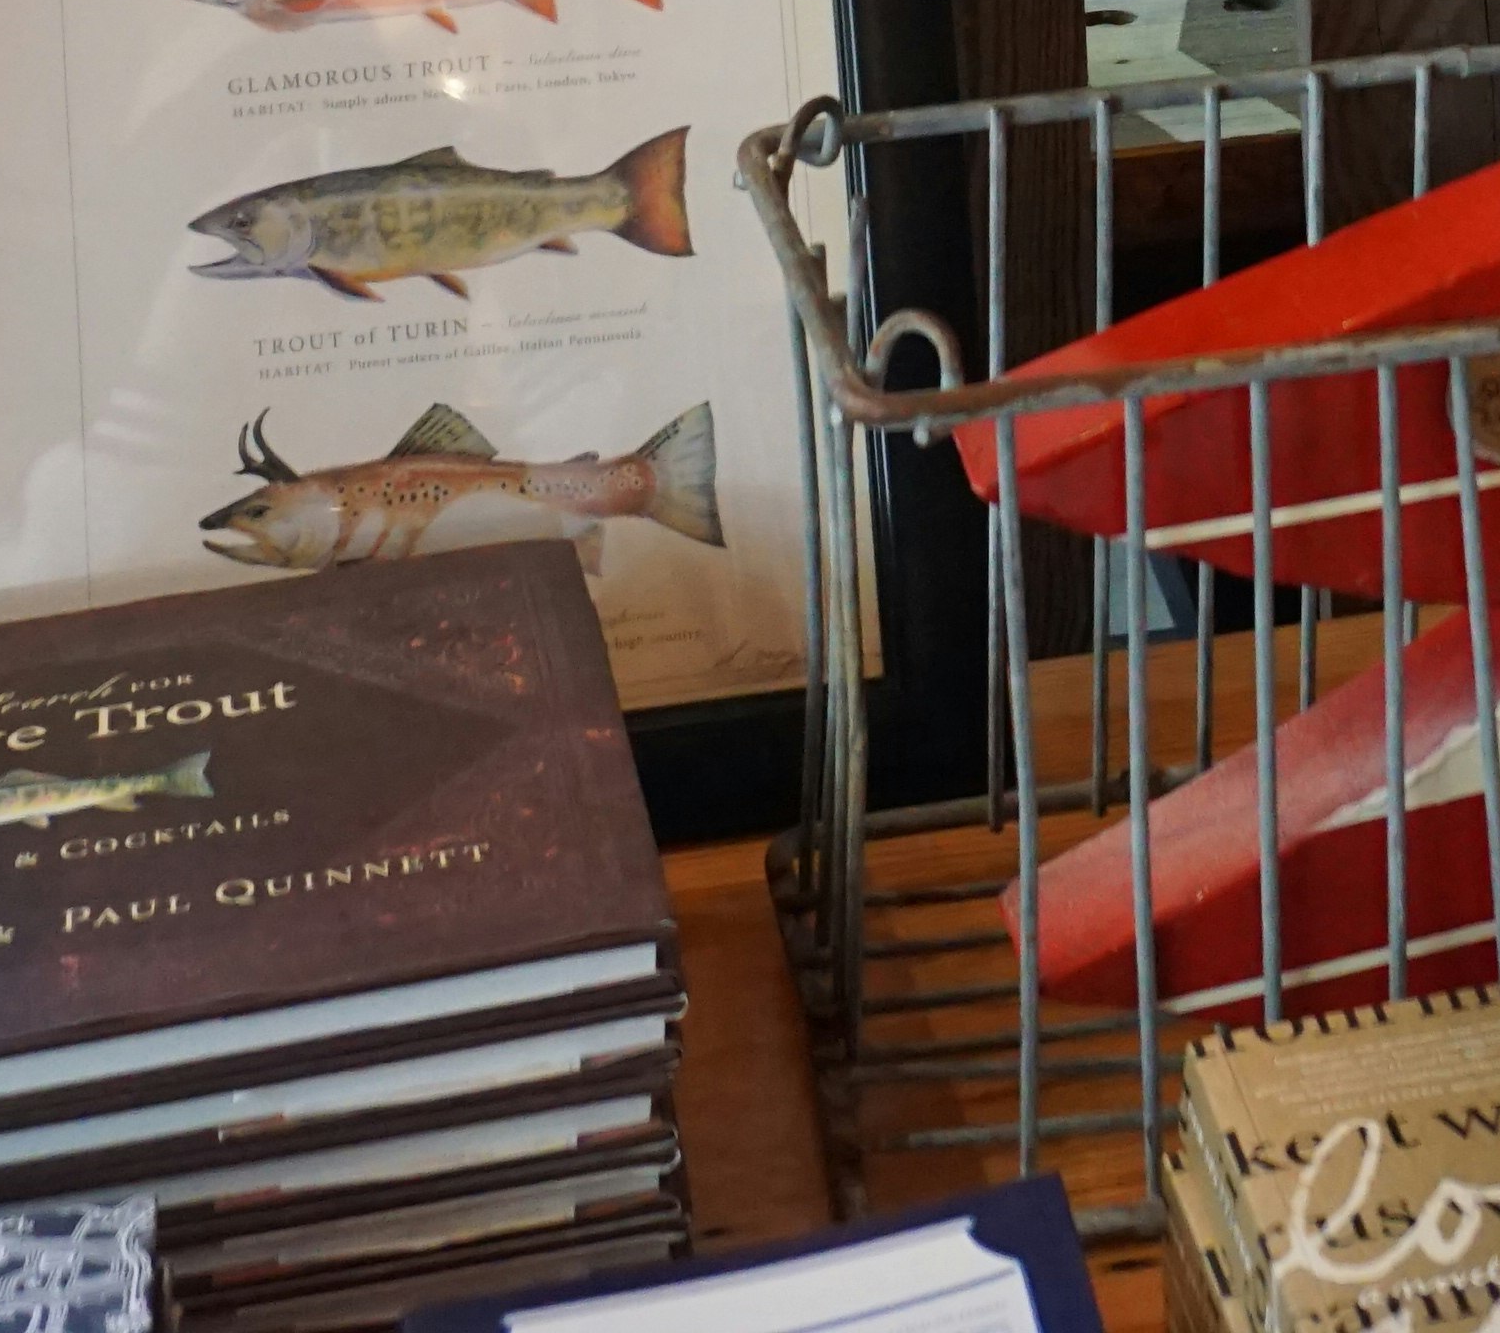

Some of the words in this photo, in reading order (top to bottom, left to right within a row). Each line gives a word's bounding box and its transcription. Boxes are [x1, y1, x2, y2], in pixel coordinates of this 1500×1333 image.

[226, 62, 398, 96] GLAMOROUS
[409, 54, 497, 76] TROUT
[252, 334, 340, 357] TROUT
[352, 329, 378, 347] of
[385, 317, 469, 343] TURIN
[131, 672, 195, 694] FOR
[73, 678, 301, 741] Trout
[14, 851, 39, 869] &
[59, 808, 291, 861] COCKTAILS
[61, 892, 192, 933] PAUL
[215, 842, 491, 906] QUINNETT
